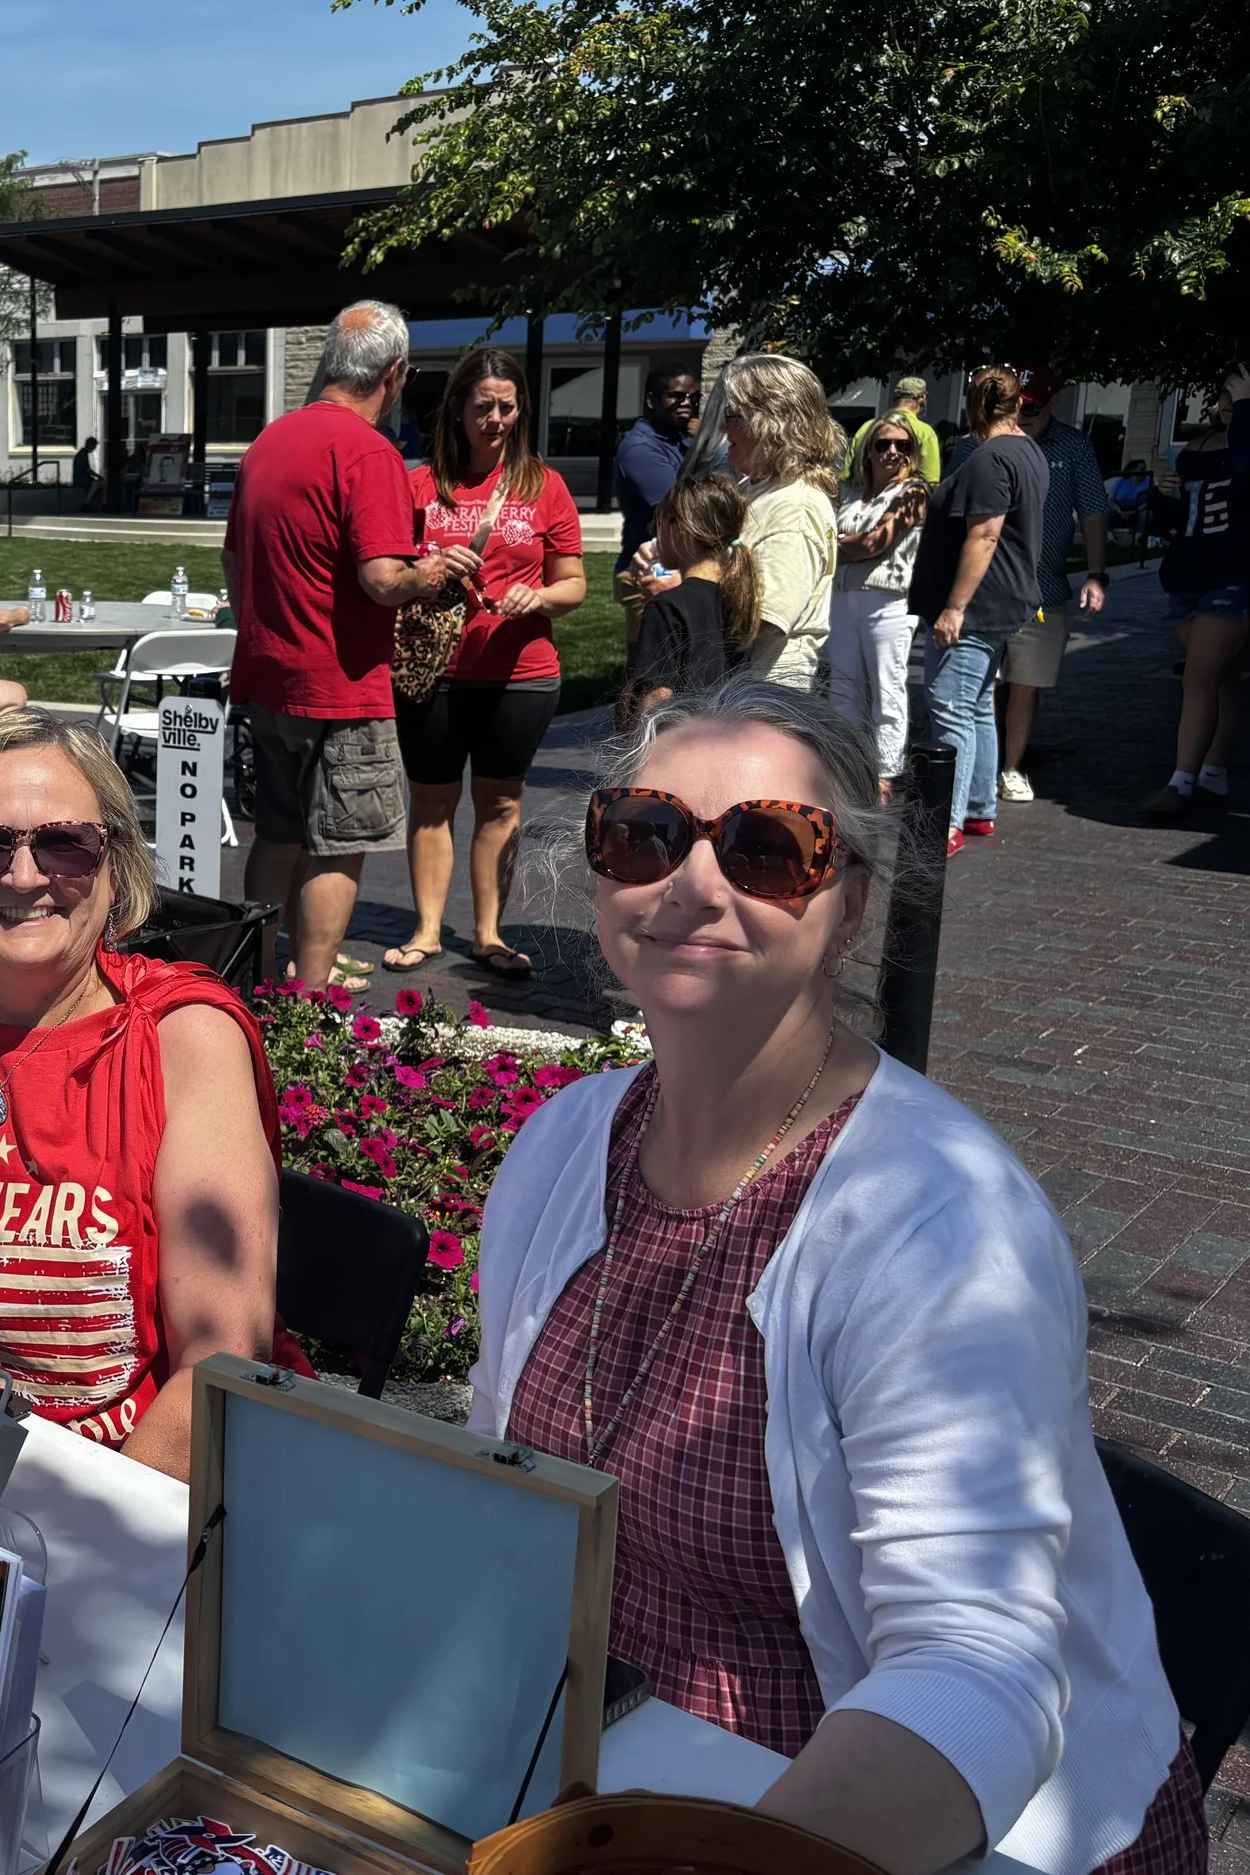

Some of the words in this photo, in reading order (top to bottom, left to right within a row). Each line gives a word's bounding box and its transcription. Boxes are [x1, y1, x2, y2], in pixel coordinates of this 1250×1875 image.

[161, 709, 219, 734] Shelby
[161, 728, 201, 747] ville.
[179, 760, 198, 800] NO
